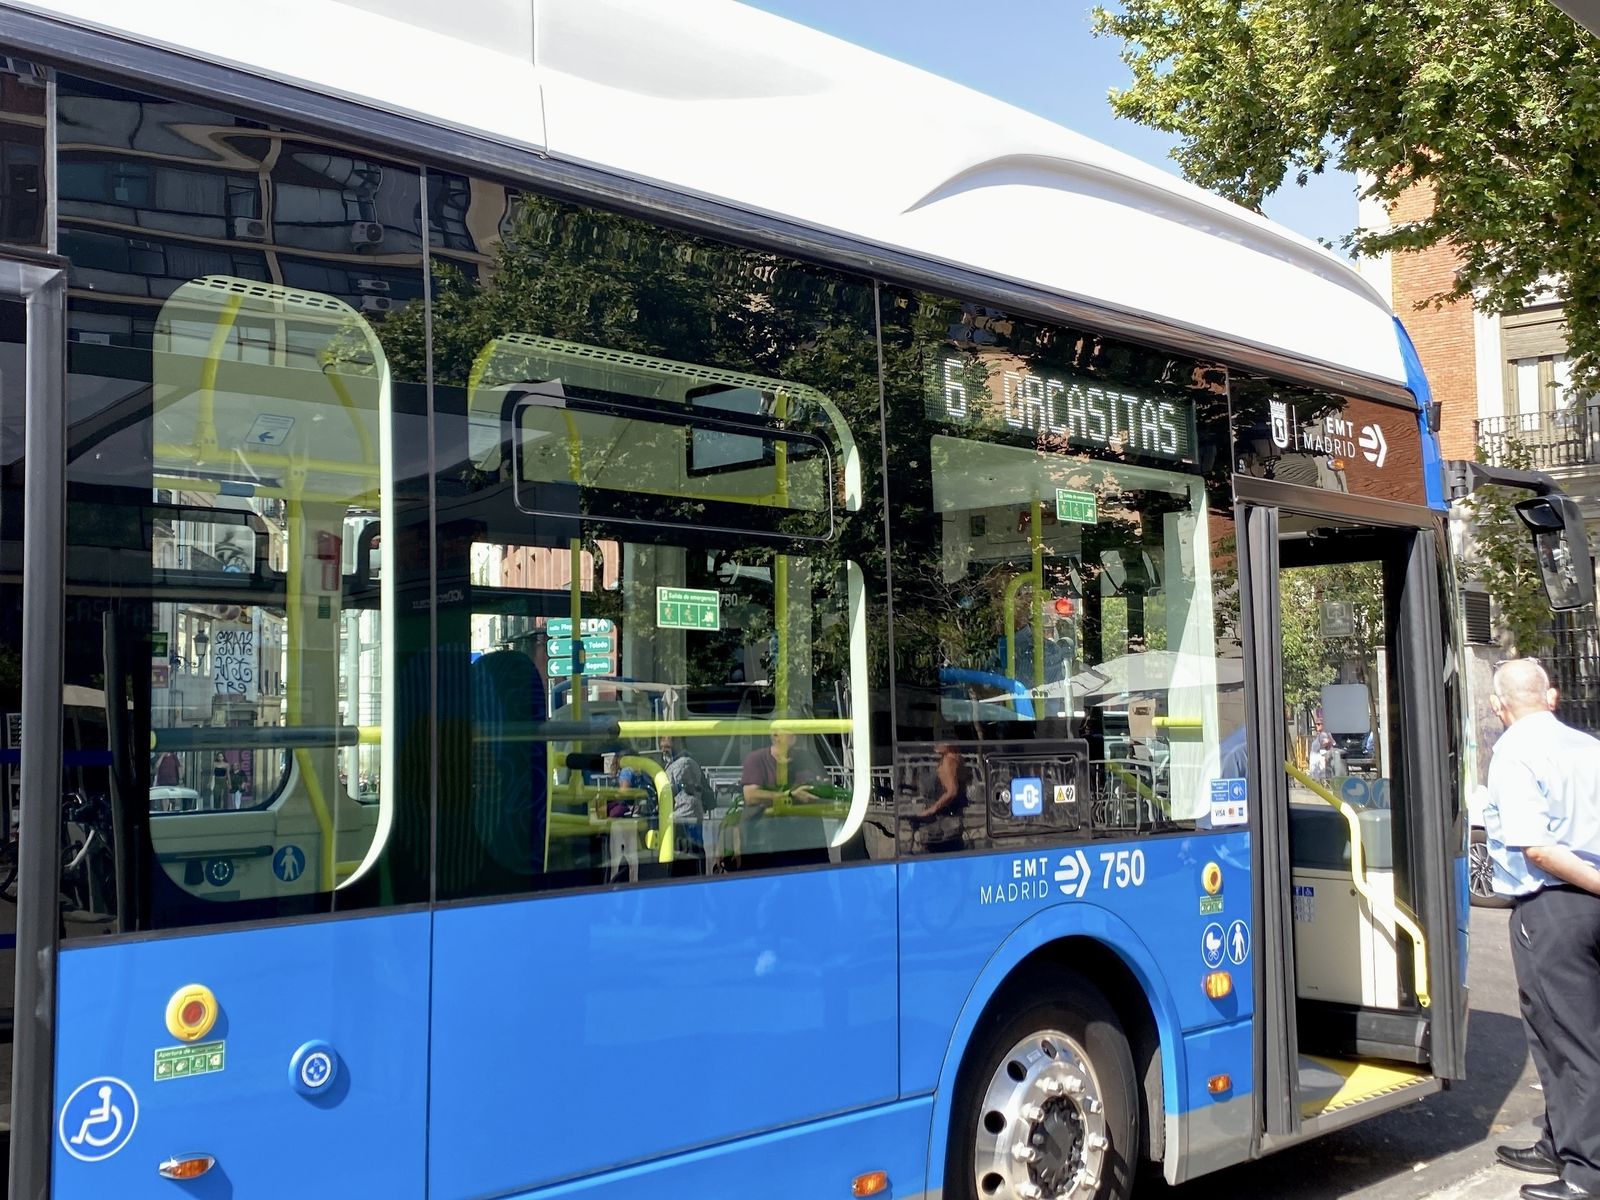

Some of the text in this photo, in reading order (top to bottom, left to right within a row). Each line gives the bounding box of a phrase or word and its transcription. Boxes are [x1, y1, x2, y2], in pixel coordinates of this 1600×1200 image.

[944, 357, 1177, 455] 6 ORCASITAS
[1326, 416, 1354, 438] EMT
[1303, 431, 1356, 458] MADRID
[668, 592, 683, 600] Salida
[690, 594, 716, 603] emergencia
[588, 641, 608, 649] Toledo
[1215, 808, 1226, 817] VISA
[1012, 849, 1146, 890] EMT 750
[980, 879, 1049, 905] MADRID
